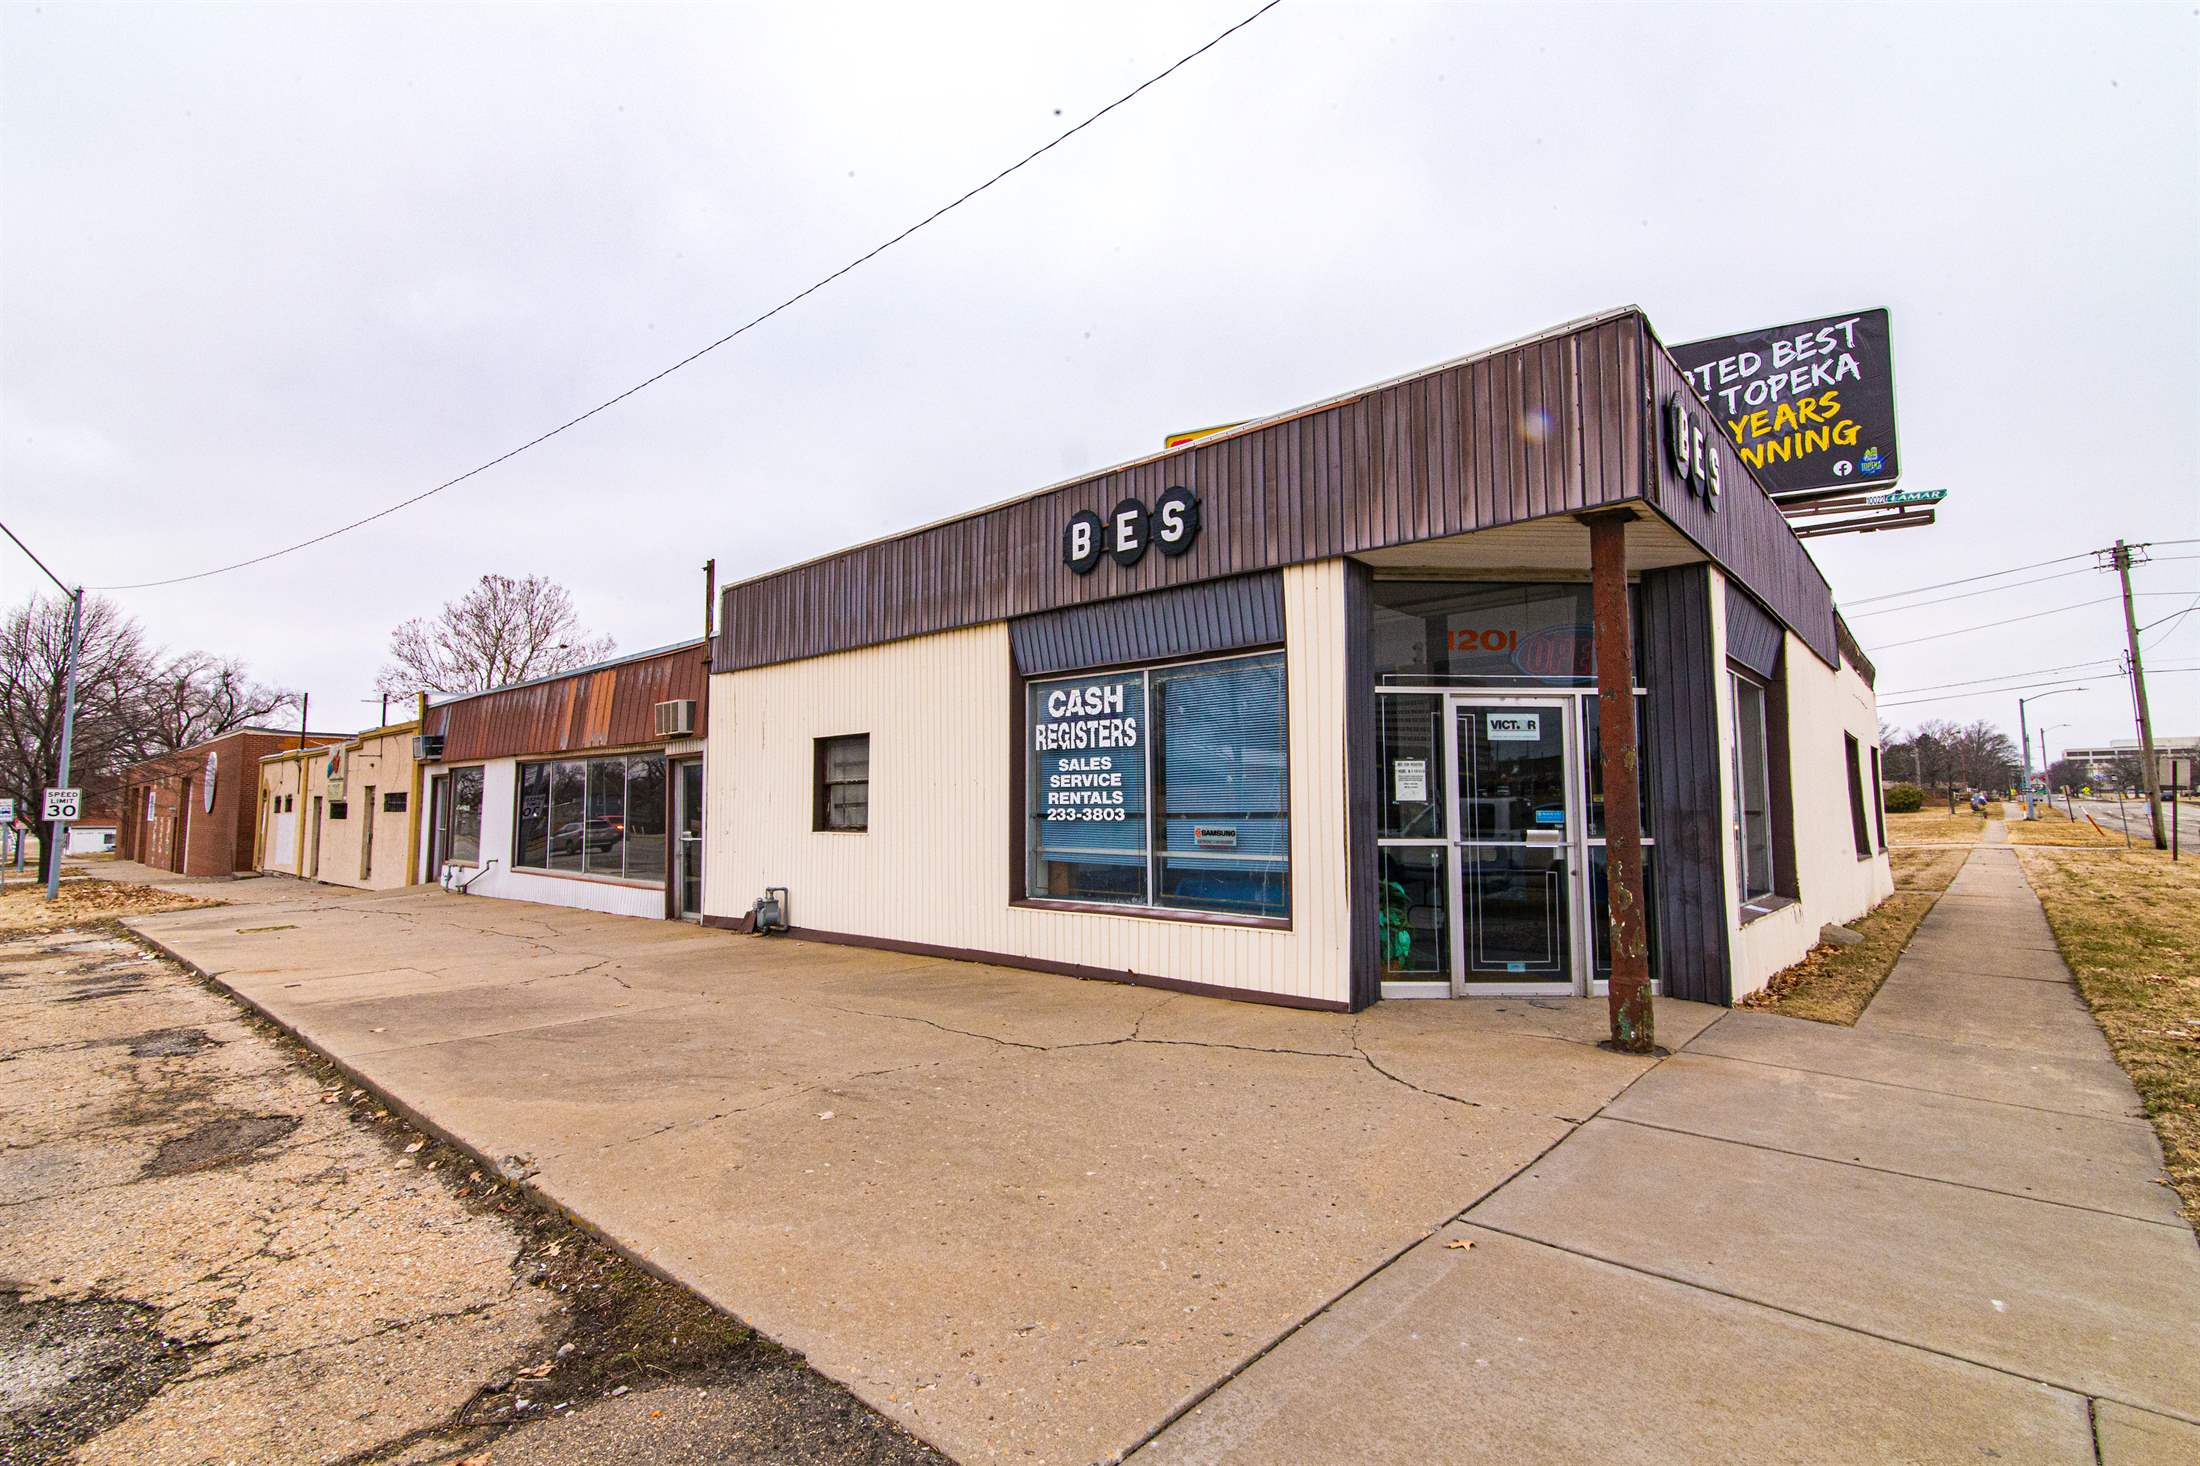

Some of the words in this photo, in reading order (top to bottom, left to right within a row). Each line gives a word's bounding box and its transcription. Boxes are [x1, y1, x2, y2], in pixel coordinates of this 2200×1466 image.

[1771, 318, 1861, 369] BEST
[1718, 352, 1862, 415] TOPEKA
[1727, 390, 1841, 445] YEARS
[1677, 405, 1720, 497] BES
[1890, 490, 1941, 502] LAMAR
[1071, 500, 1186, 561] BES
[1446, 628, 1518, 652] 1201
[1526, 637, 1596, 675] OPE
[1048, 684, 1124, 718] CASH
[1035, 717, 1137, 751] REGISTERS
[1058, 756, 1112, 772] SALES
[1049, 772, 1122, 788] SERVICE
[47, 804, 77, 817] 30
[1048, 790, 1124, 805] RENTALS
[1047, 807, 1126, 821] 233-3803
[1201, 829, 1236, 838] SAMSUNG
